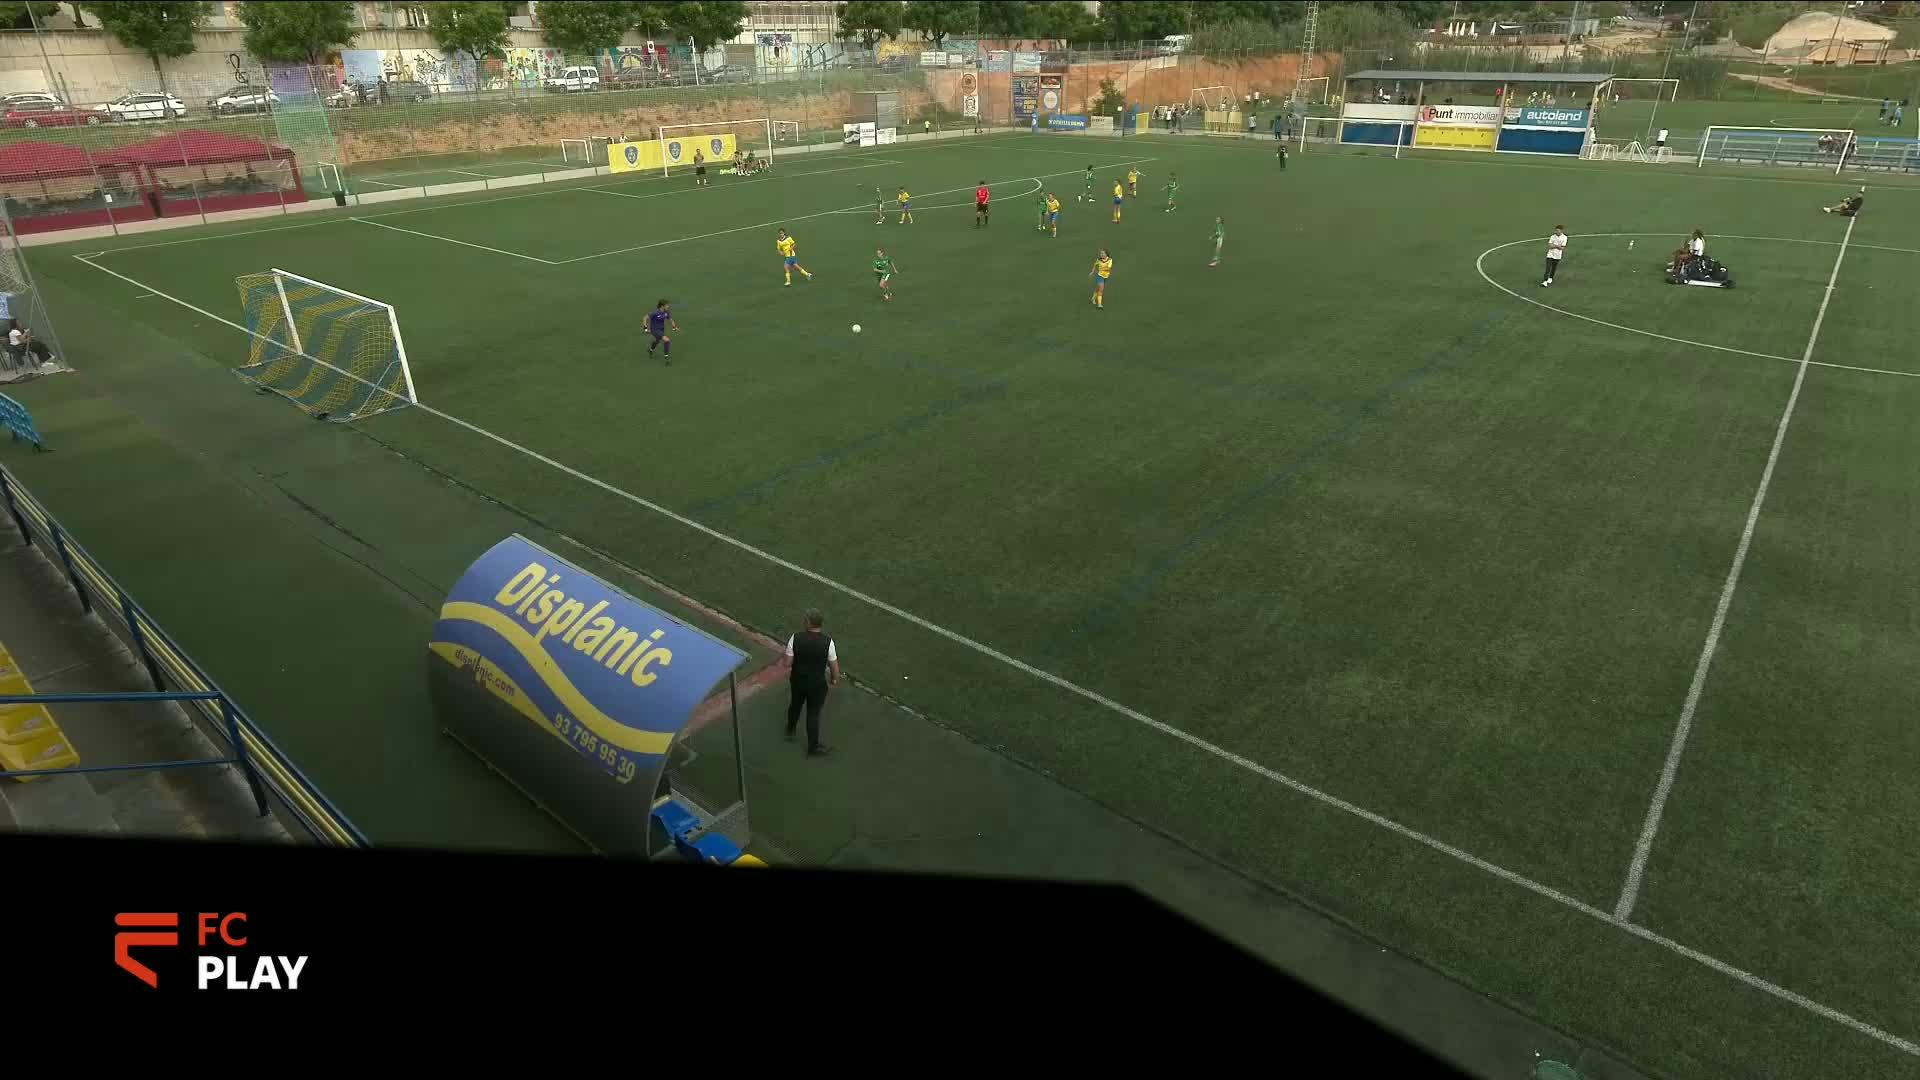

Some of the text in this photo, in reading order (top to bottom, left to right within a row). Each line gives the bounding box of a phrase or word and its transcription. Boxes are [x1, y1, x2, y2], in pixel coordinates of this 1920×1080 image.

[1428, 108, 1453, 119] Punt
[1526, 110, 1583, 121] autoland
[494, 562, 673, 688] Displanic
[455, 648, 515, 697] displanic.com
[554, 712, 571, 735] 93
[573, 725, 598, 753] 795
[599, 743, 617, 766] 95
